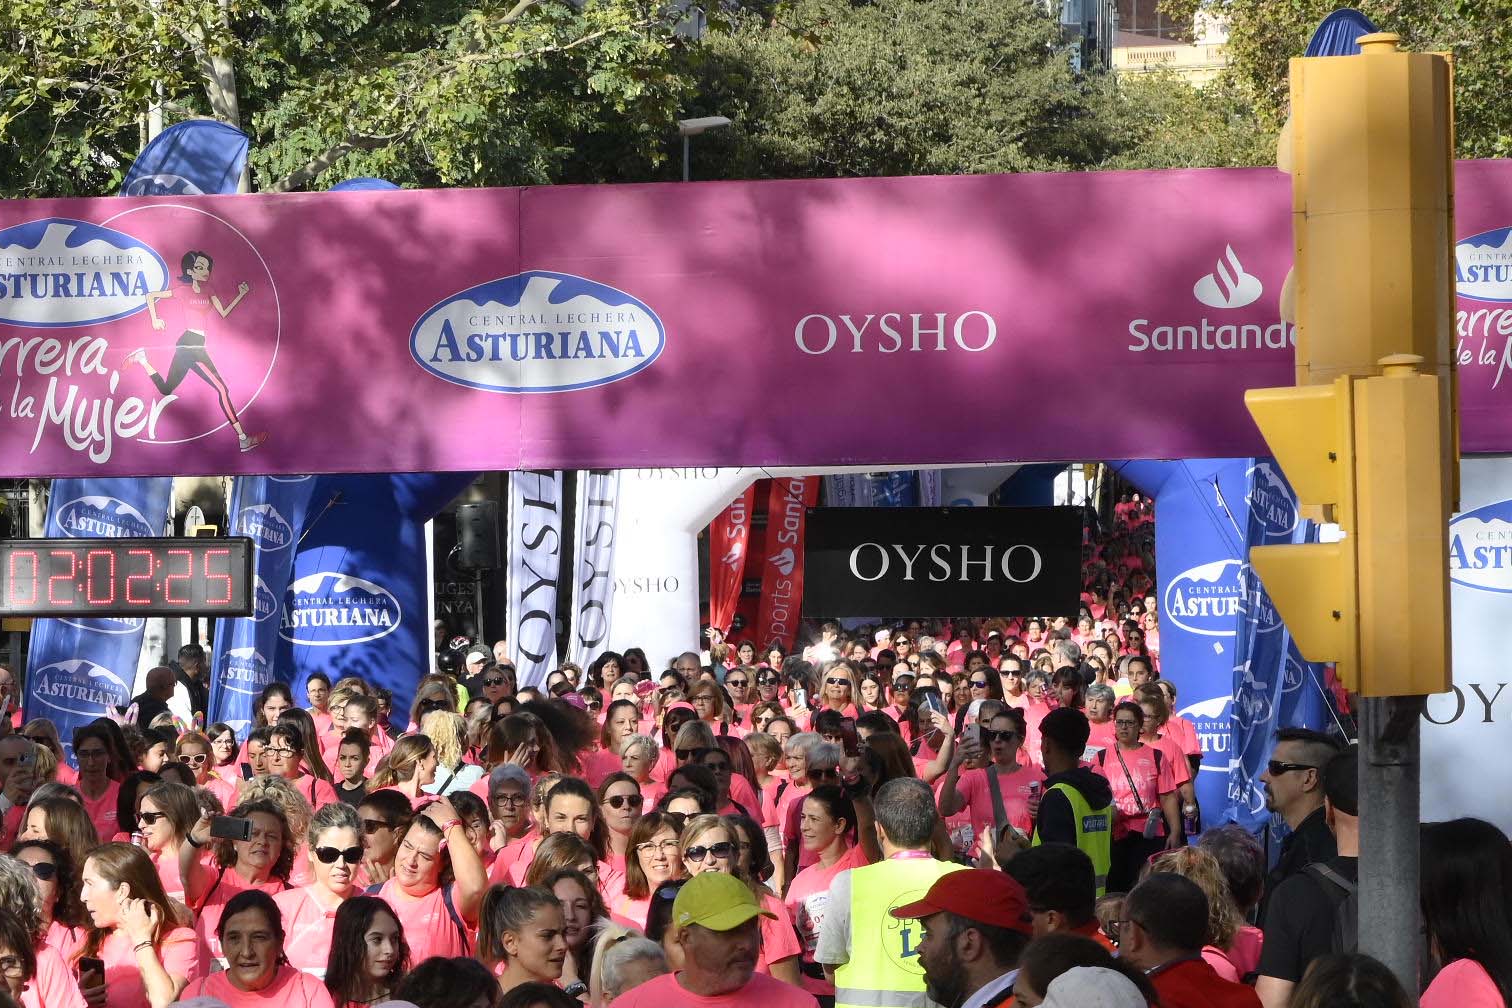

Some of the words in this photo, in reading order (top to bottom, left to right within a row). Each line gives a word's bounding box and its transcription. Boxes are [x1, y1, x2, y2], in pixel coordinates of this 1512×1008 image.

[73, 254, 144, 267] LECHERA
[469, 314, 547, 327] CENTRAL
[556, 312, 636, 325] LECHERA
[795, 310, 998, 355] OYSHO
[430, 318, 645, 363] ASTURIANA
[1479, 338, 1497, 365] la
[11, 380, 36, 418] la
[30, 370, 178, 464] Mujer
[777, 475, 806, 545] Santa
[10, 550, 233, 604] 02:02:25
[518, 470, 559, 664] OYSH
[579, 470, 614, 649] OYSH
[848, 542, 1042, 584] OYSHO
[292, 597, 334, 605] CENTRAL
[338, 597, 387, 605] LECHERA
[613, 575, 680, 593] YSHO
[1172, 588, 1239, 616] ASTUR
[279, 602, 392, 629] ASTURIANA
[36, 674, 123, 706] ASTURIANA
